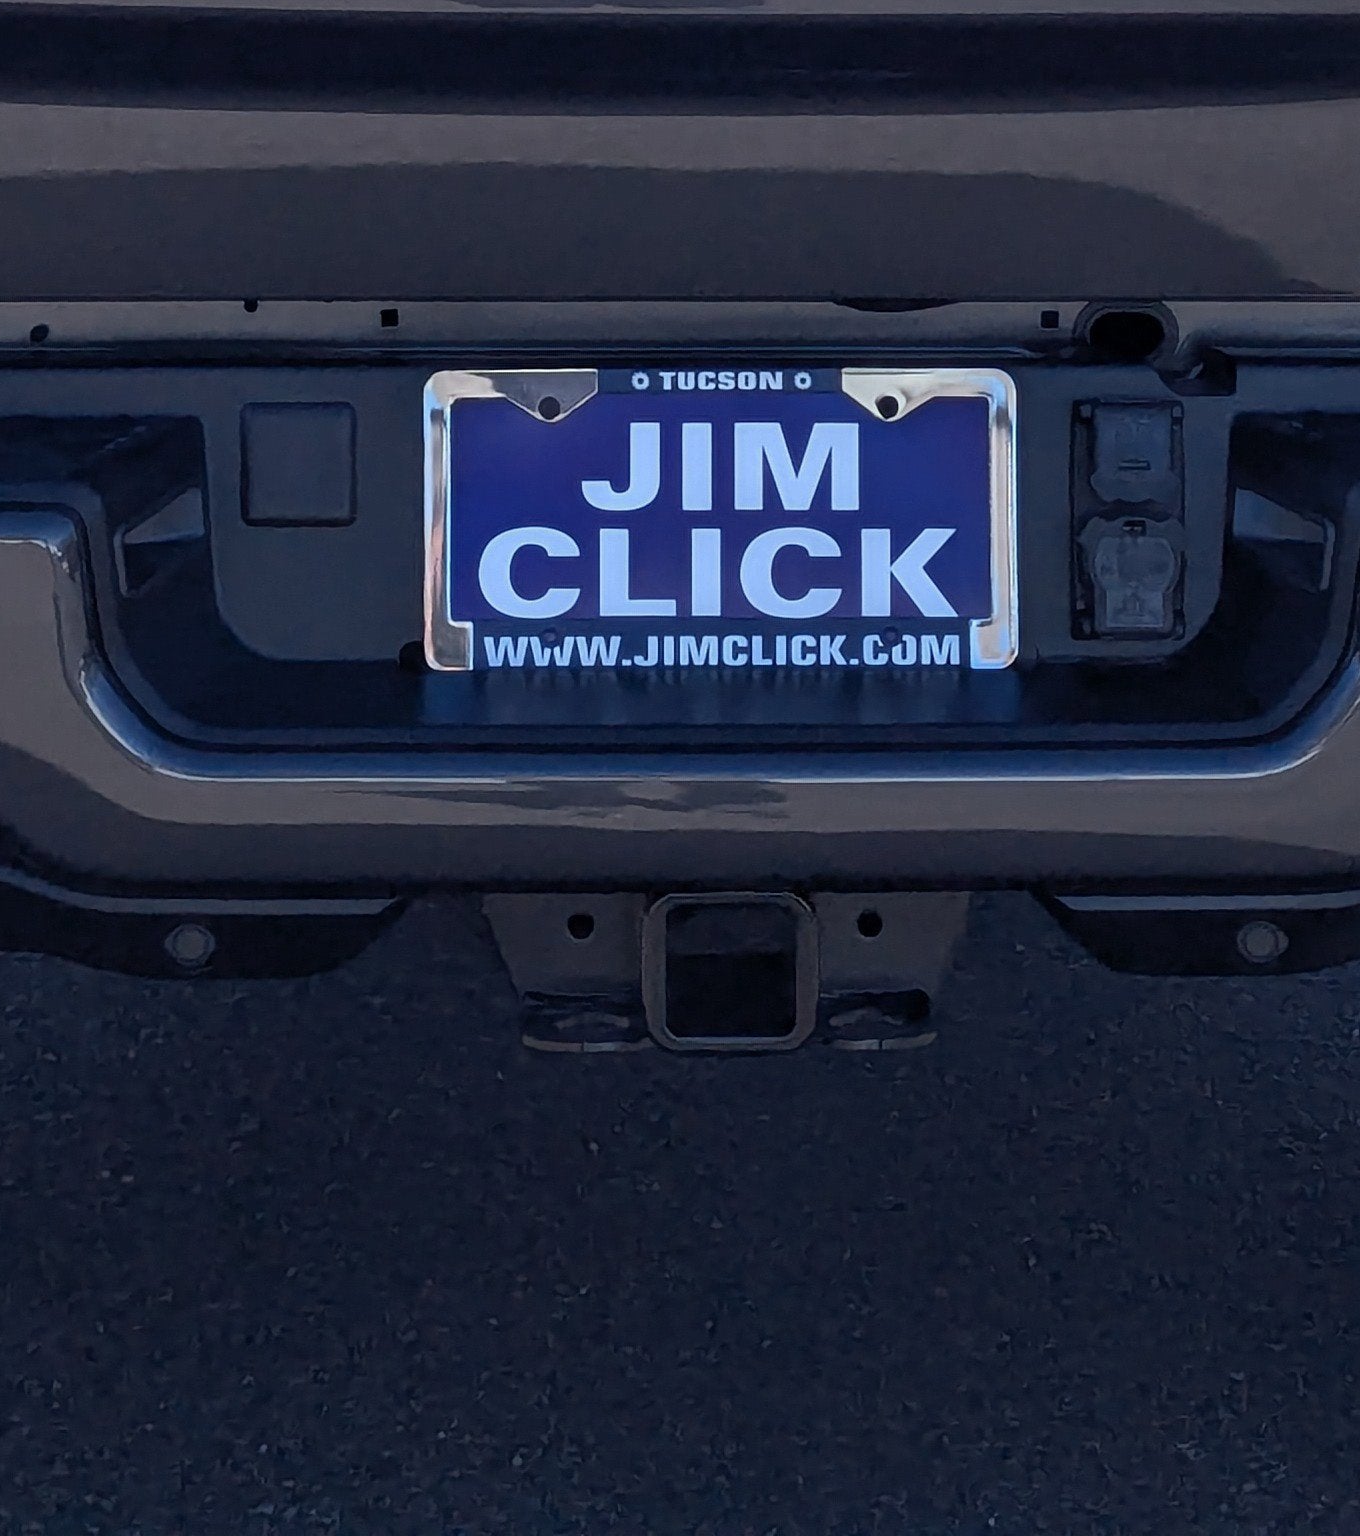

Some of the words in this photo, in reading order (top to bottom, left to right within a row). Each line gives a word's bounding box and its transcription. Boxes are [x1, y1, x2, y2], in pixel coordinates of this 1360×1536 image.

[659, 371, 783, 391] TUCSON
[581, 422, 860, 511] JIM
[478, 526, 957, 618] CLICK
[484, 634, 960, 667] WWW.JIMCLICK.COM
